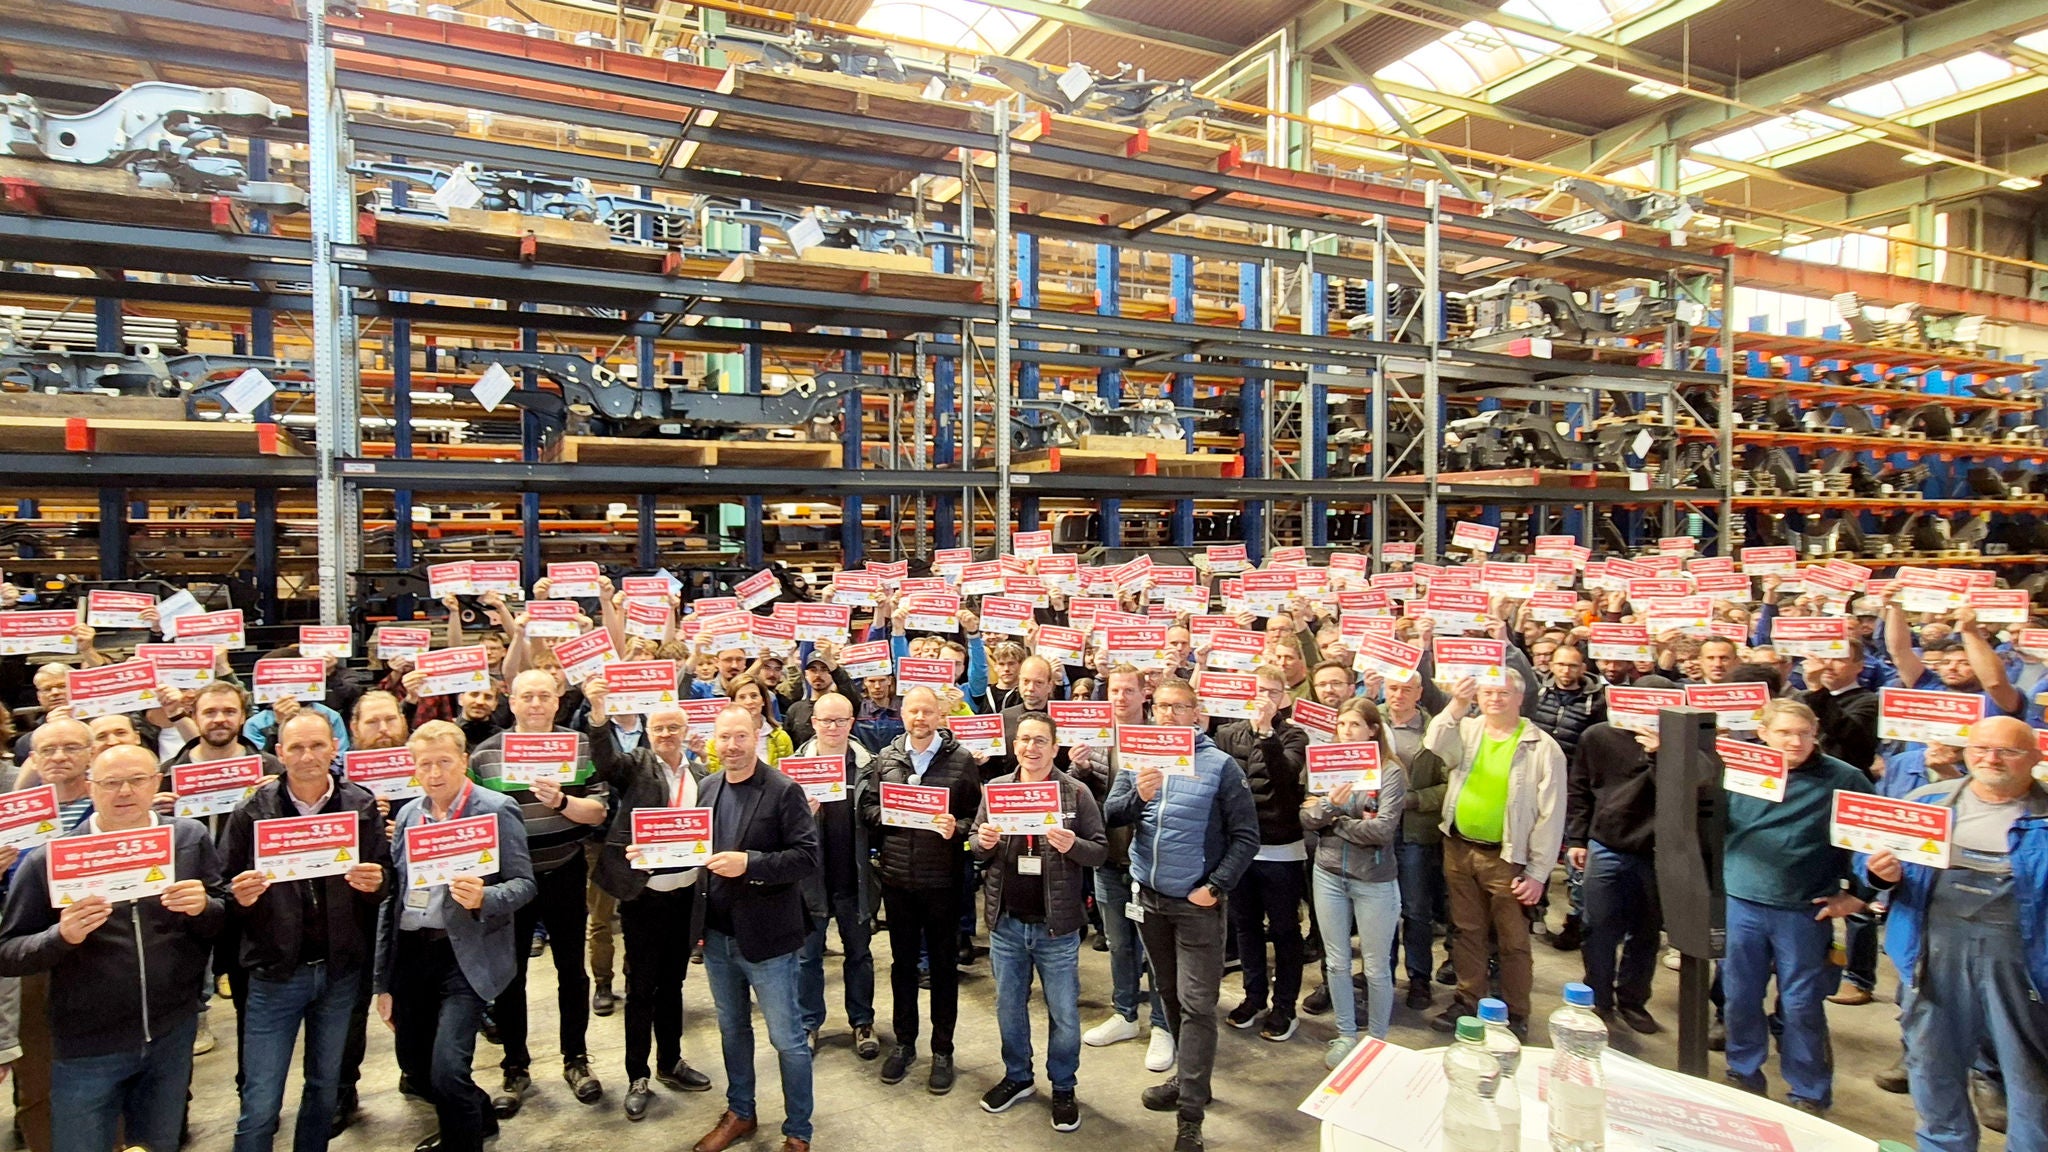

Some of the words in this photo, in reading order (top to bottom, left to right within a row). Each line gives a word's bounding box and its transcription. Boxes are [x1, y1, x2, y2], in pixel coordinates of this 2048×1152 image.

[1471, 646, 1486, 655] 3,5
[640, 670, 656, 680] 3,5
[1934, 700, 1956, 712] 3,5
[1082, 708, 1097, 718] 3,5
[1157, 735, 1173, 744] 3,5
[542, 741, 559, 751] 3,5
[1344, 750, 1360, 759] 3,5
[388, 756, 406, 766] 3,5
[220, 767, 240, 778] 3,5
[916, 793, 930, 803] 3,5
[1024, 790, 1040, 801] 3,5
[4, 800, 29, 815] 3,5
[1894, 809, 1919, 824] 3,5
[675, 818, 692, 829] 3,5
[311, 824, 332, 837] 3,5
[334, 824, 345, 833] %
[455, 828, 475, 840] 3,5
[116, 840, 142, 856] 3,5
[145, 841, 158, 850] %
[1606, 1096, 1664, 1114] ordern
[1668, 1104, 1718, 1128] 3,5
[1728, 1121, 1756, 1136] %
